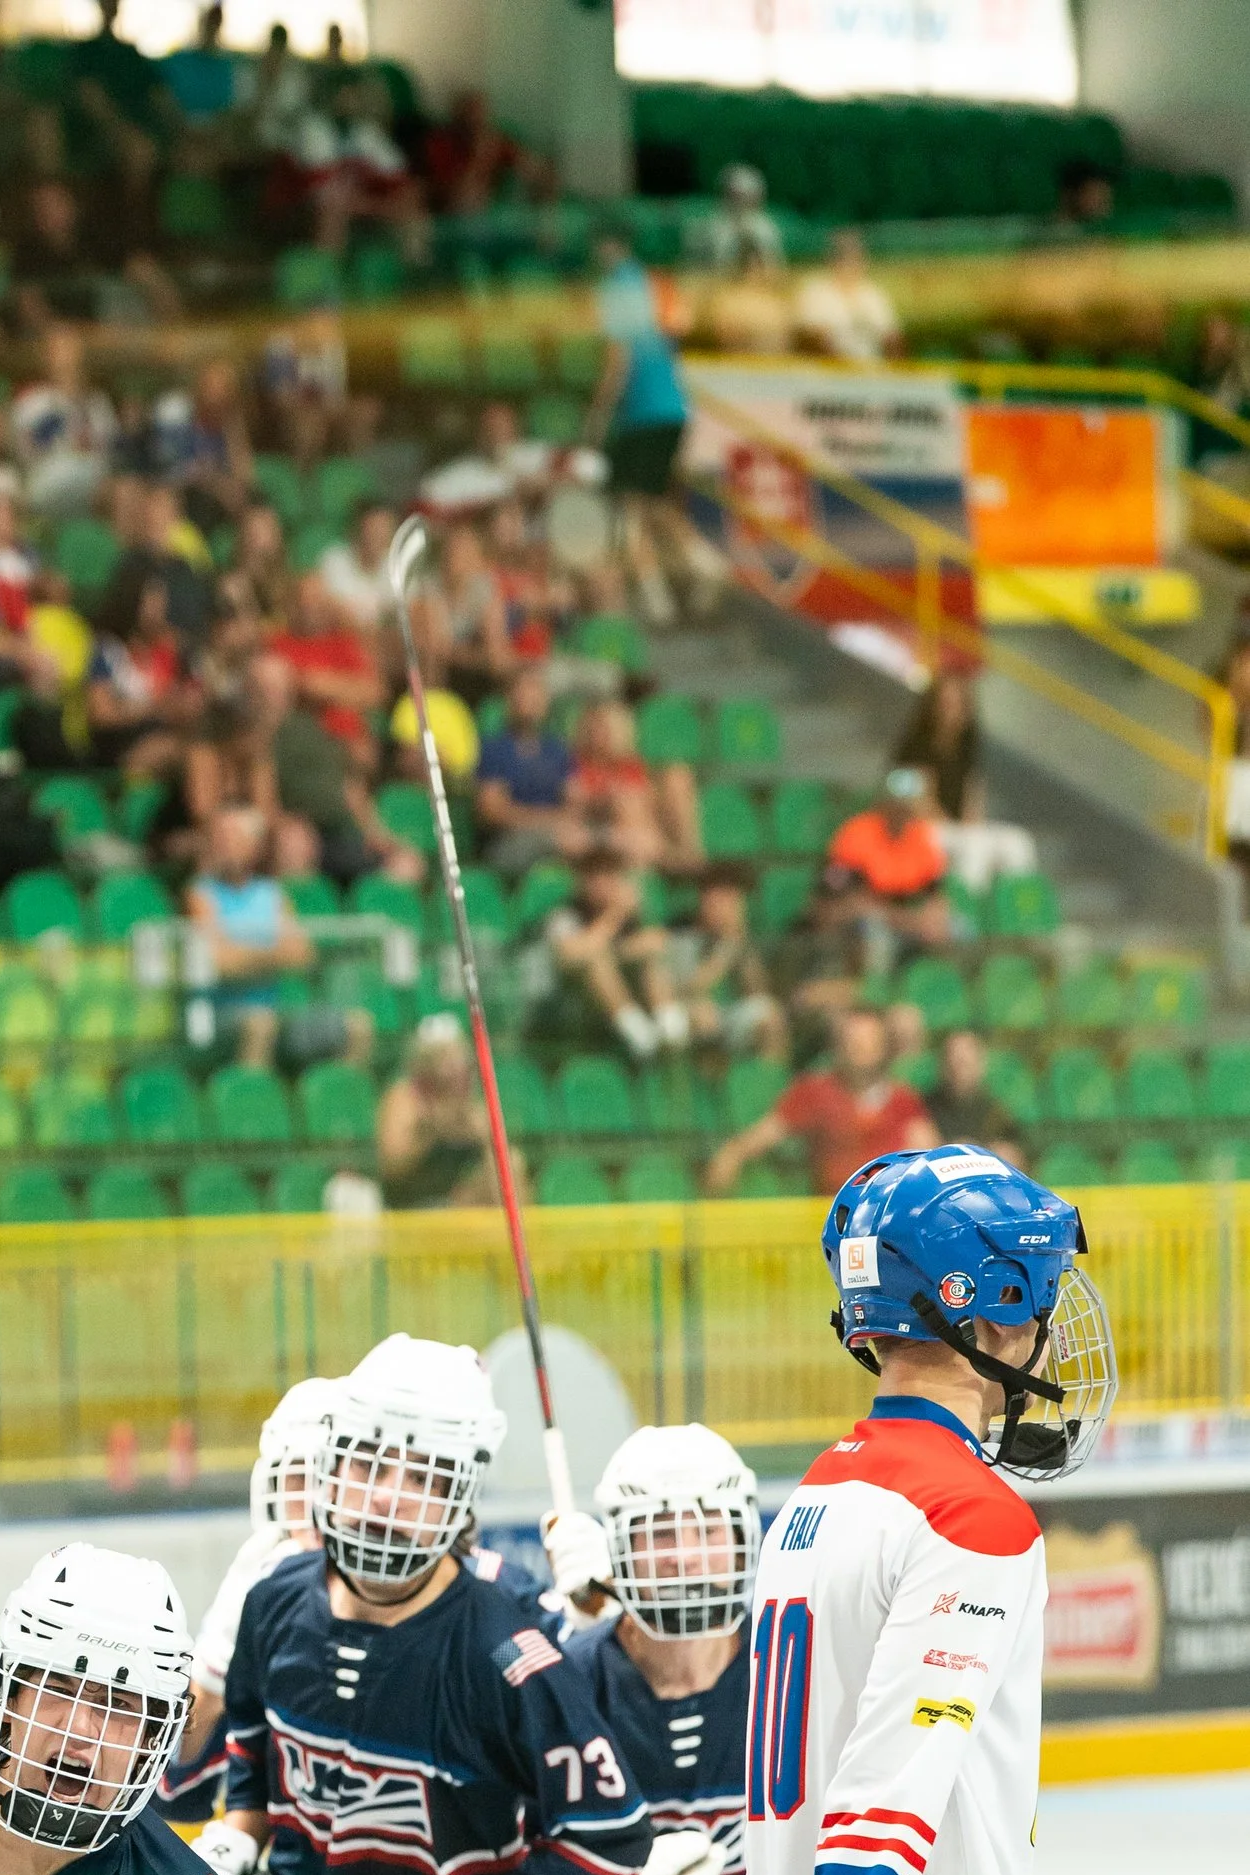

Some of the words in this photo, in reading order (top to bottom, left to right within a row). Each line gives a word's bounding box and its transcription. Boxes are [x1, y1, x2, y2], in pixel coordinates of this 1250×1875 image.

[1018, 1235, 1050, 1244] CCM
[780, 1505, 828, 1551] FIALA
[76, 1632, 140, 1656] BAUER
[748, 1597, 814, 1822] 10
[544, 1735, 627, 1802] 73
